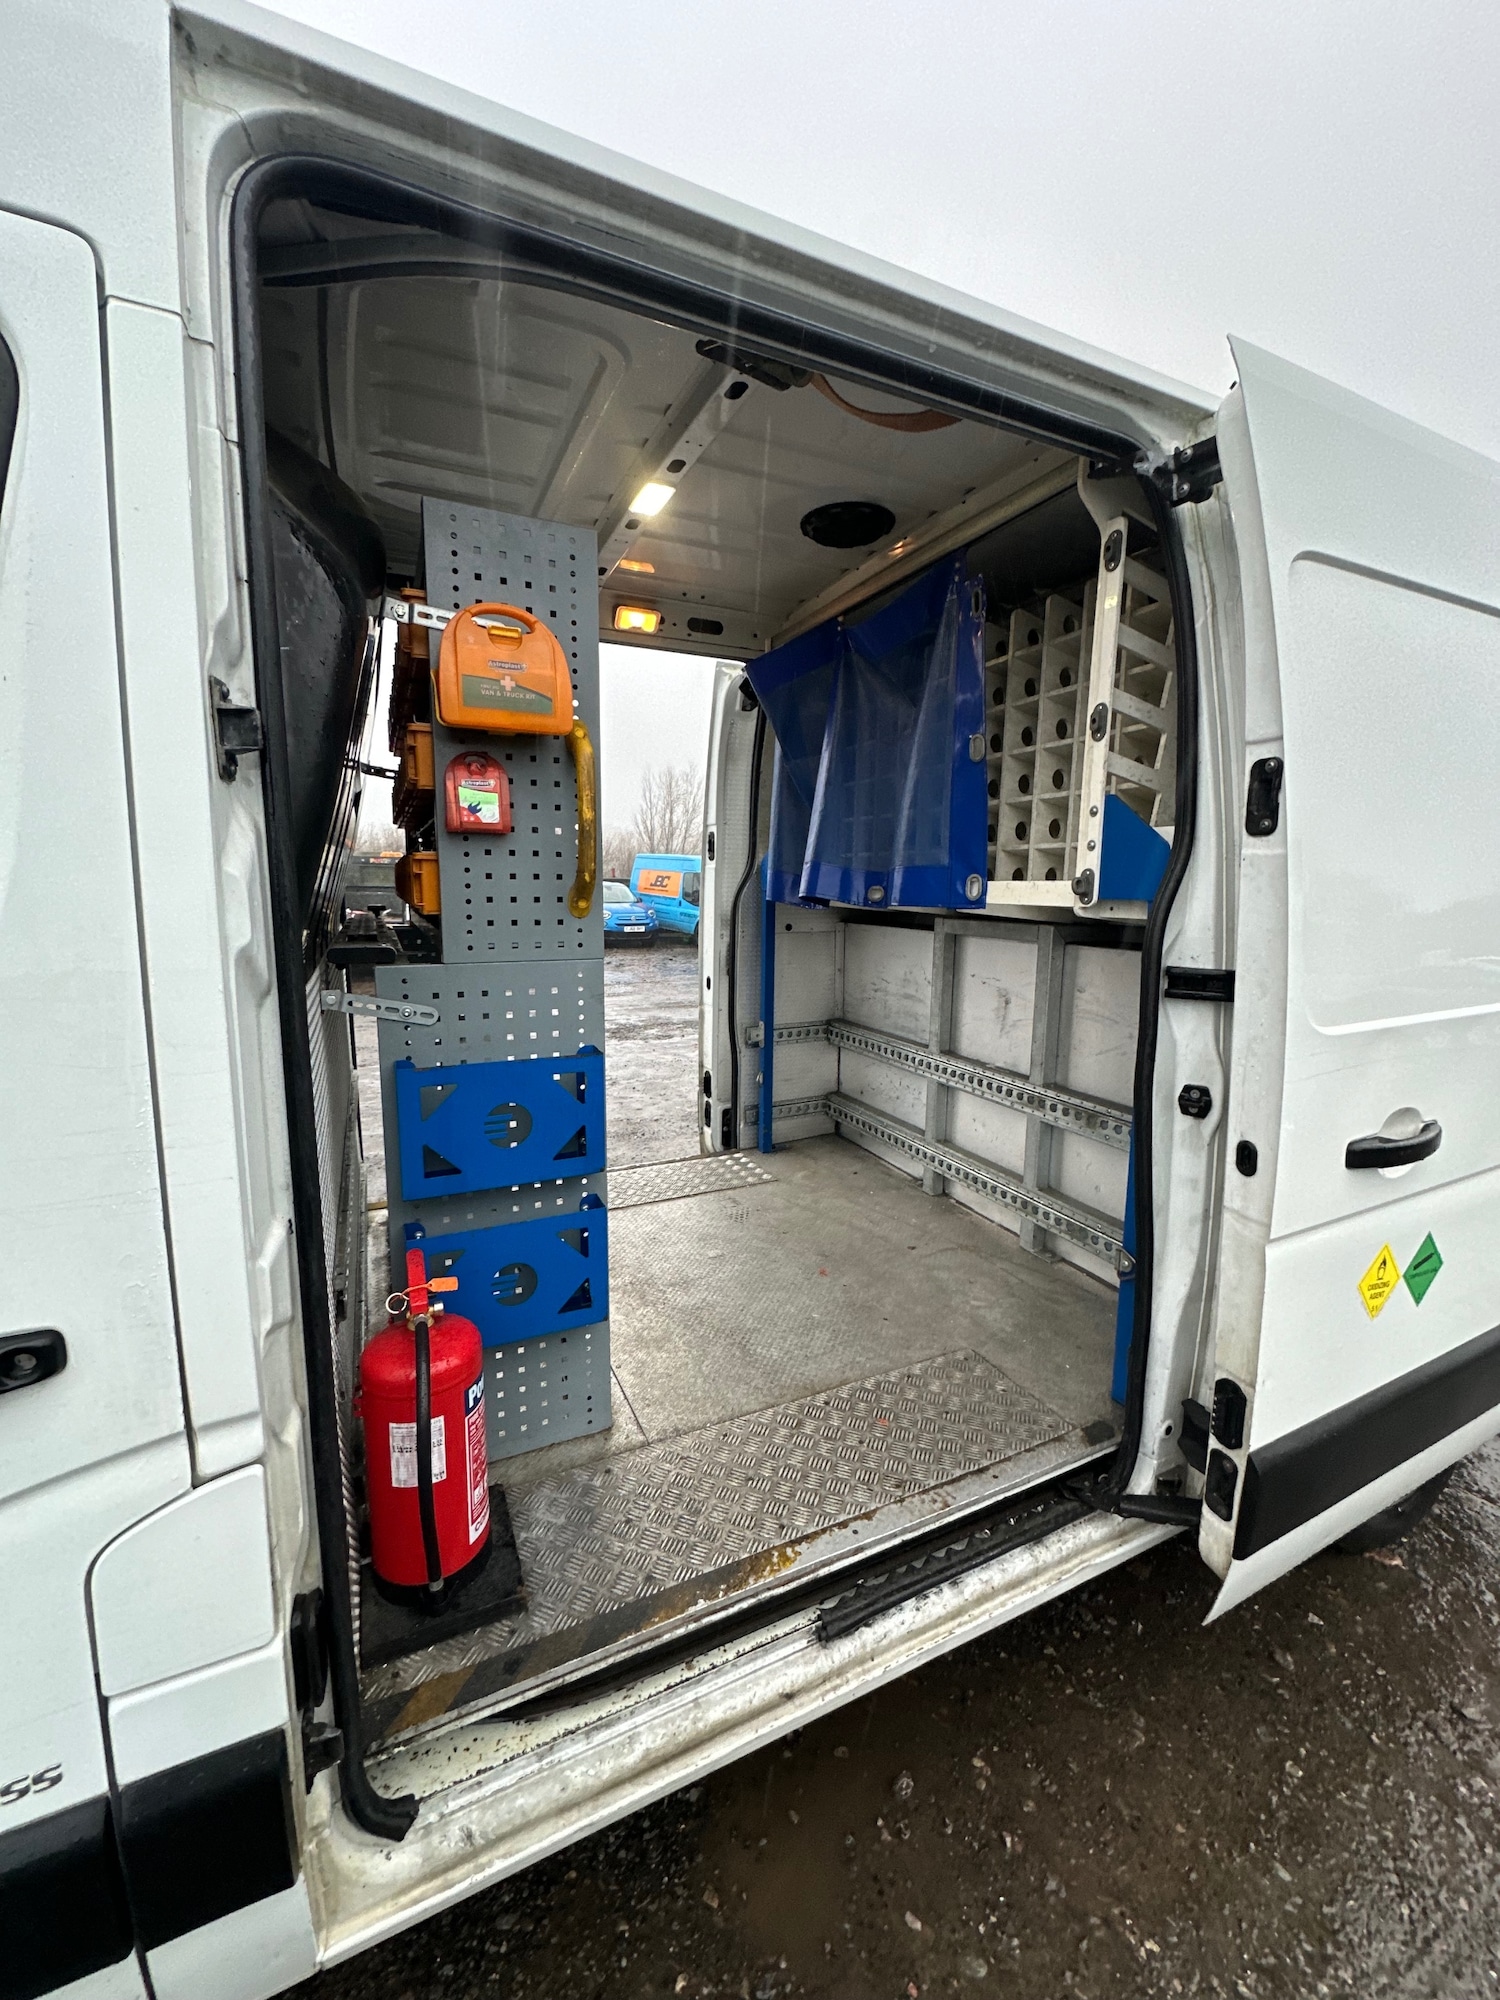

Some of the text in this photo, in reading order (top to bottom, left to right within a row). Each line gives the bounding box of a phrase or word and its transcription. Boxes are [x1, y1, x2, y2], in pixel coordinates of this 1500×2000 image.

[488, 660, 521, 670] Astroplast
[503, 691, 525, 699] TRUCK
[1369, 1290, 1386, 1300] AGENT
